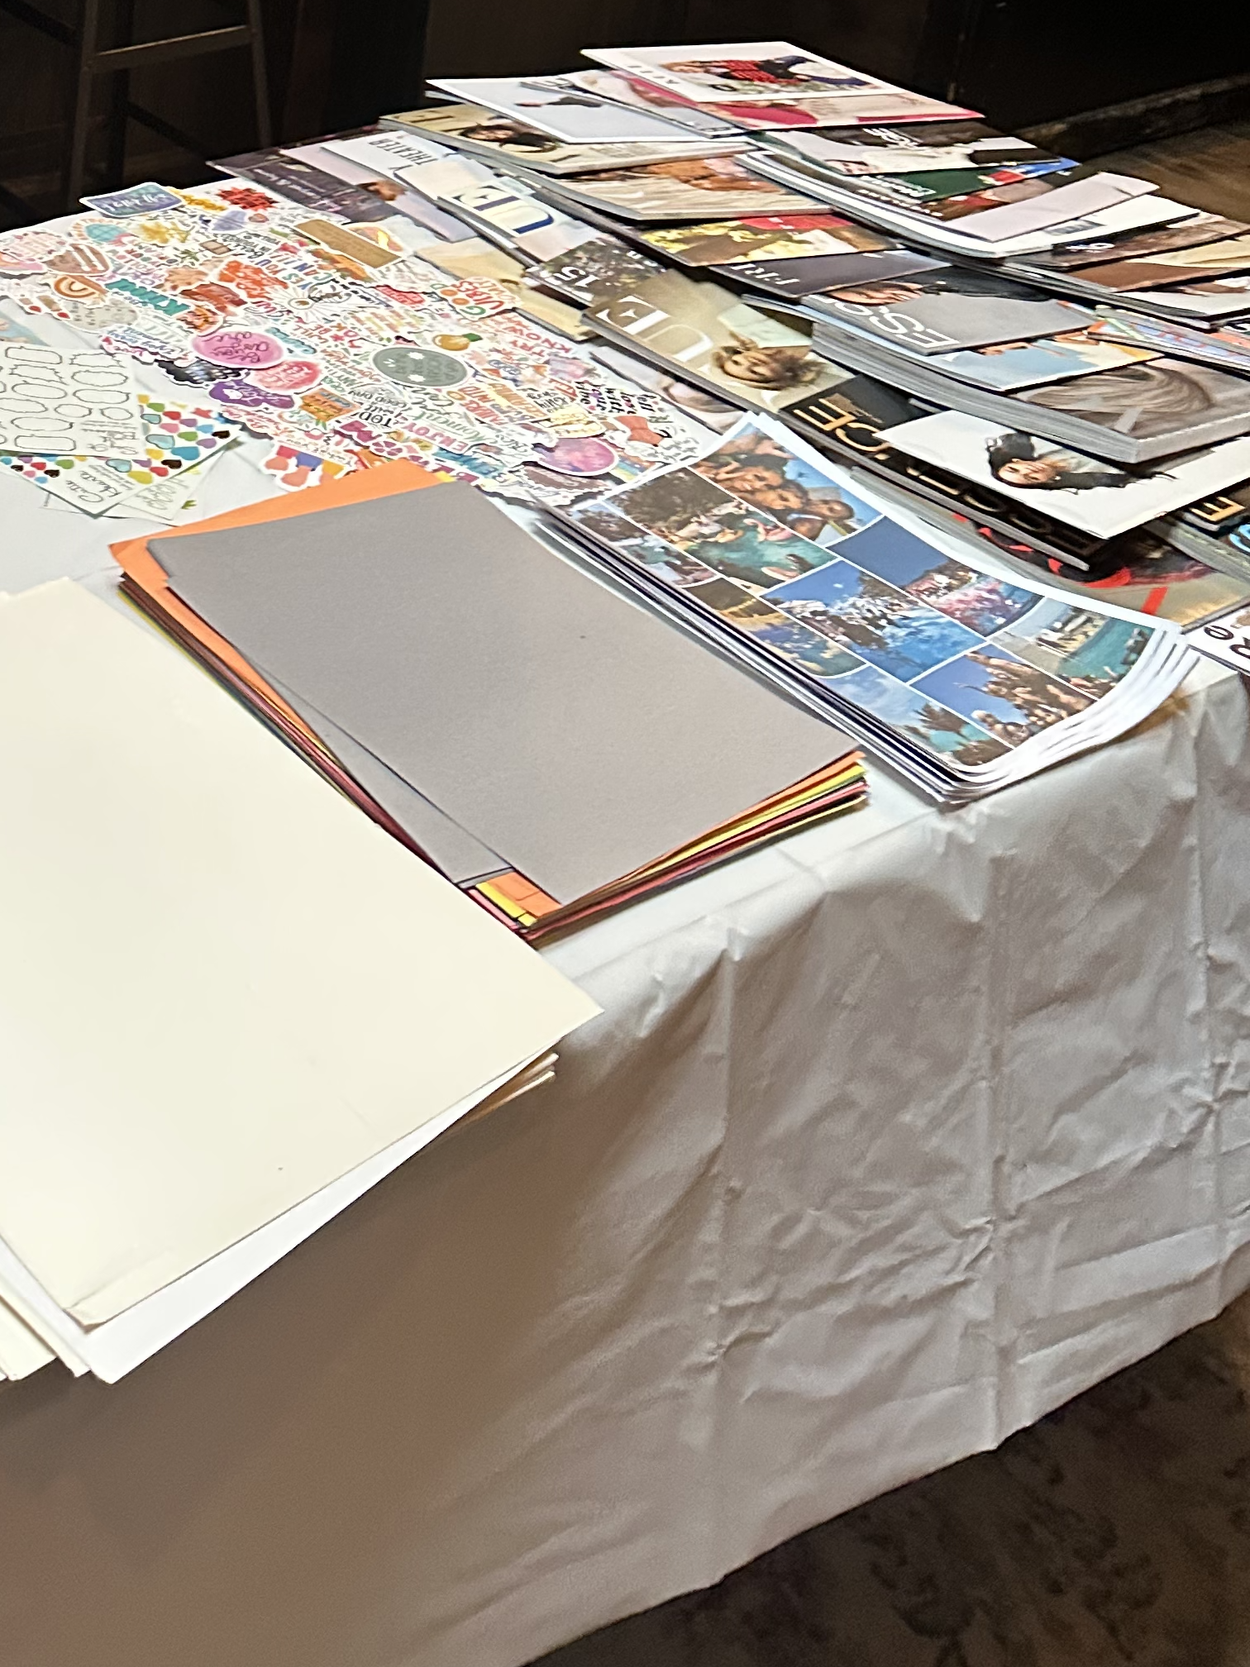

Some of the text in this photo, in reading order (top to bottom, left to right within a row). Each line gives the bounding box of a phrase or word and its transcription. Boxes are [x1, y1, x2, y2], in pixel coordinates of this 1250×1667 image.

[368, 139, 438, 165] THEATER
[255, 259, 312, 290] YES YOU
[552, 266, 600, 288] 15
[430, 283, 486, 316] GOOD
[450, 279, 505, 309] VIBES
[502, 326, 571, 353] KNOW
[509, 340, 545, 357] TRY
